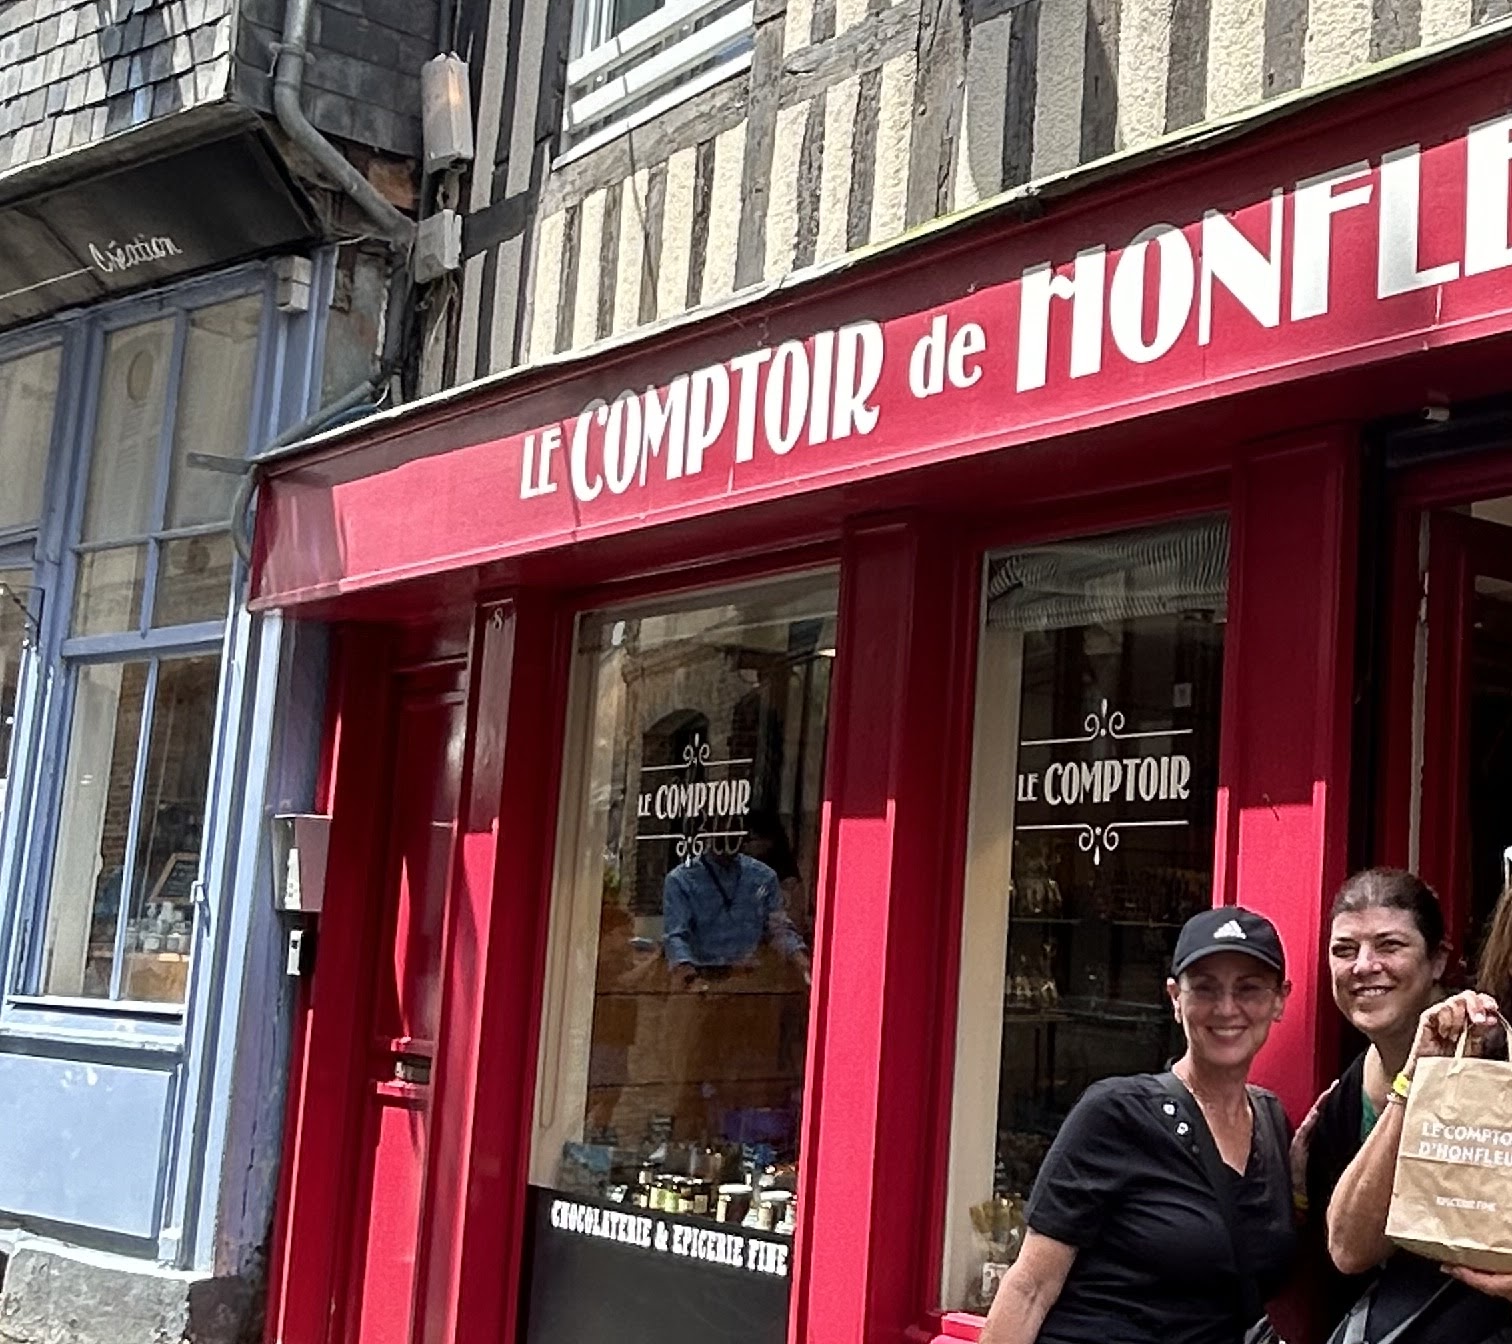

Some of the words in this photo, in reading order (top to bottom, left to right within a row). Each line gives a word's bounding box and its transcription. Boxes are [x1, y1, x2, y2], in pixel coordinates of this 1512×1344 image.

[520, 422, 563, 500] LE
[570, 320, 885, 502] COMPTOIR
[909, 312, 984, 398] de
[638, 792, 652, 816] LE
[655, 778, 751, 820] COMPTOIR
[1017, 773, 1039, 802] LE
[1044, 755, 1191, 805] COMPTOIR
[1421, 1121, 1441, 1137] LE
[551, 1199, 651, 1248] CHOCOLATERIE
[655, 1220, 668, 1251] &
[672, 1223, 744, 1268] EPICERIE
[746, 1238, 788, 1277] FINE
